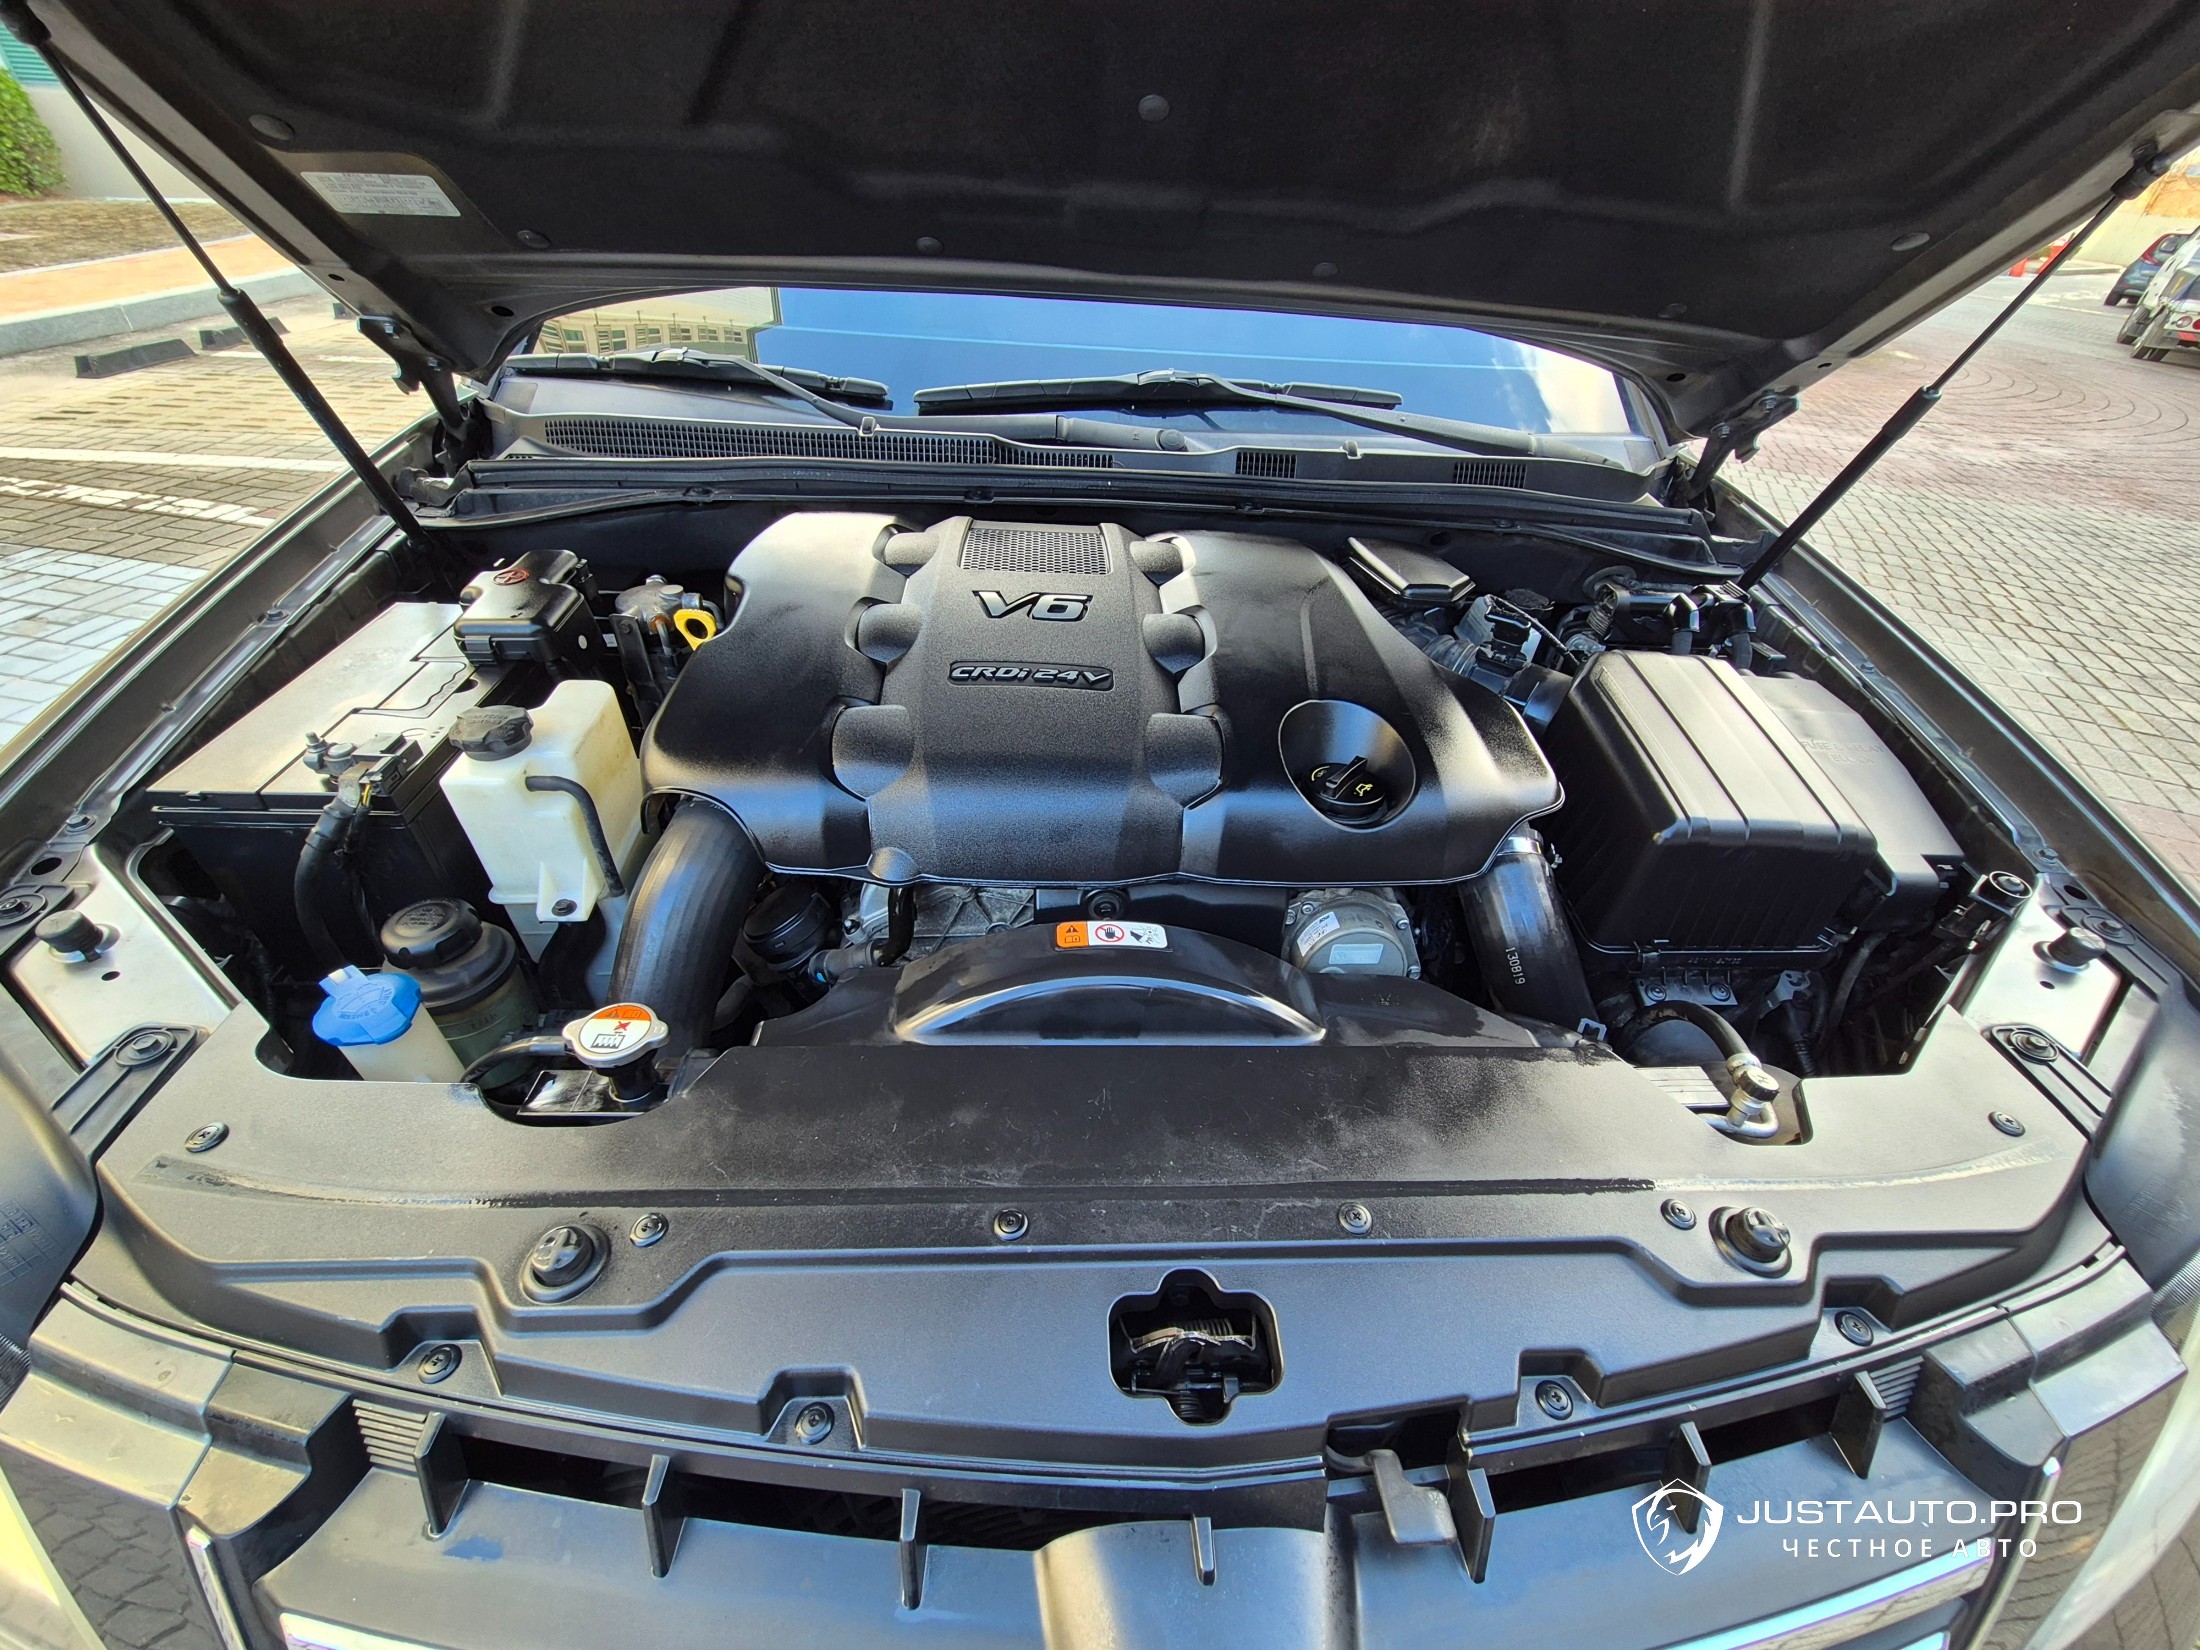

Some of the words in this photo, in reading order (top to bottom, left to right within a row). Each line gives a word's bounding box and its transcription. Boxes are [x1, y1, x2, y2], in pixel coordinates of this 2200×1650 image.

[973, 590, 1093, 622] V6
[951, 666, 1031, 682] CRDi
[1032, 668, 1111, 685] 24V
[1505, 946, 1526, 985] 130819
